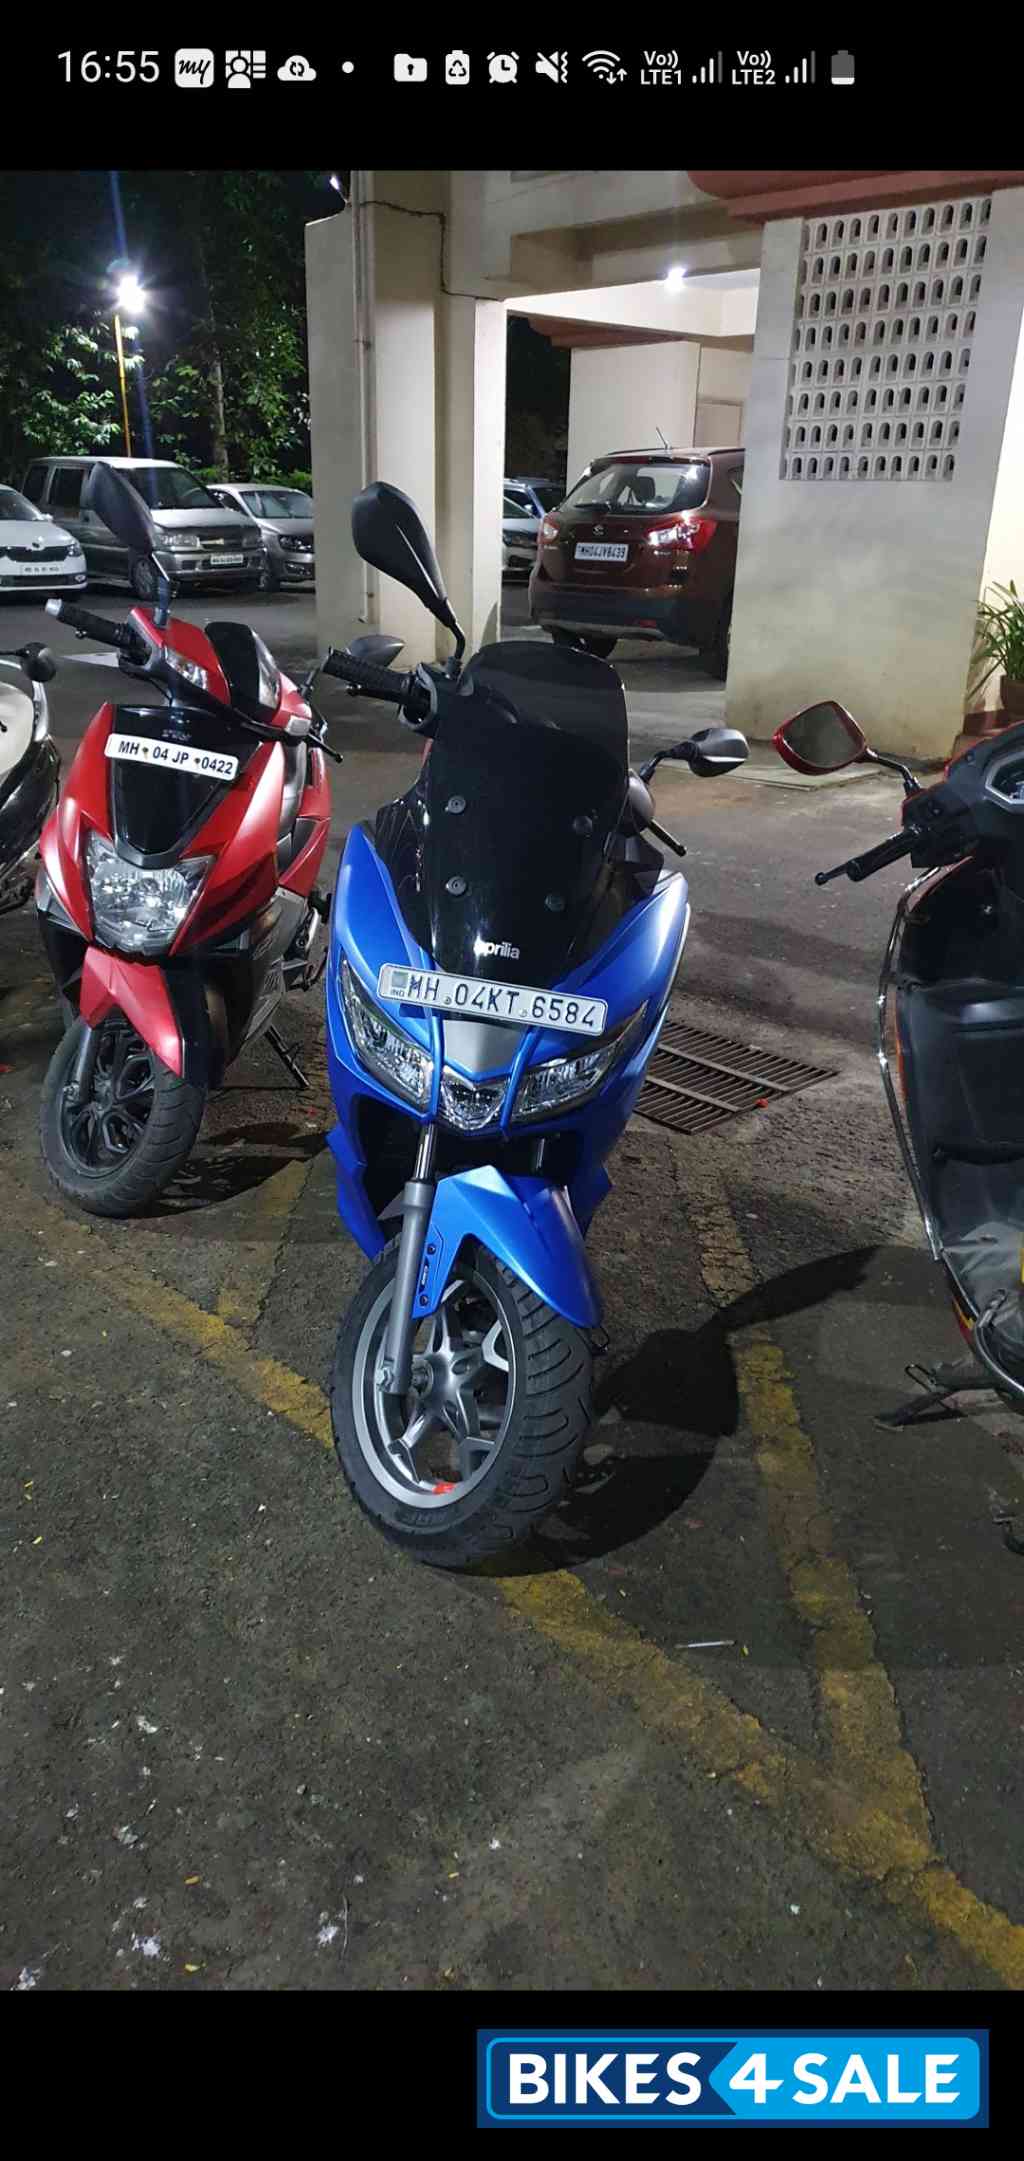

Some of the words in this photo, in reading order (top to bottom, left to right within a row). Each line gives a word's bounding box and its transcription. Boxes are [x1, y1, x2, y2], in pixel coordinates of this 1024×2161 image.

[117, 740, 140, 756] MH
[152, 746, 169, 761] 04
[171, 750, 189, 765] JP
[201, 756, 234, 775] 0422
[473, 940, 521, 961] prilia
[407, 974, 440, 1001] MH
[454, 983, 520, 1016] 04KT
[531, 996, 597, 1028] 6584
